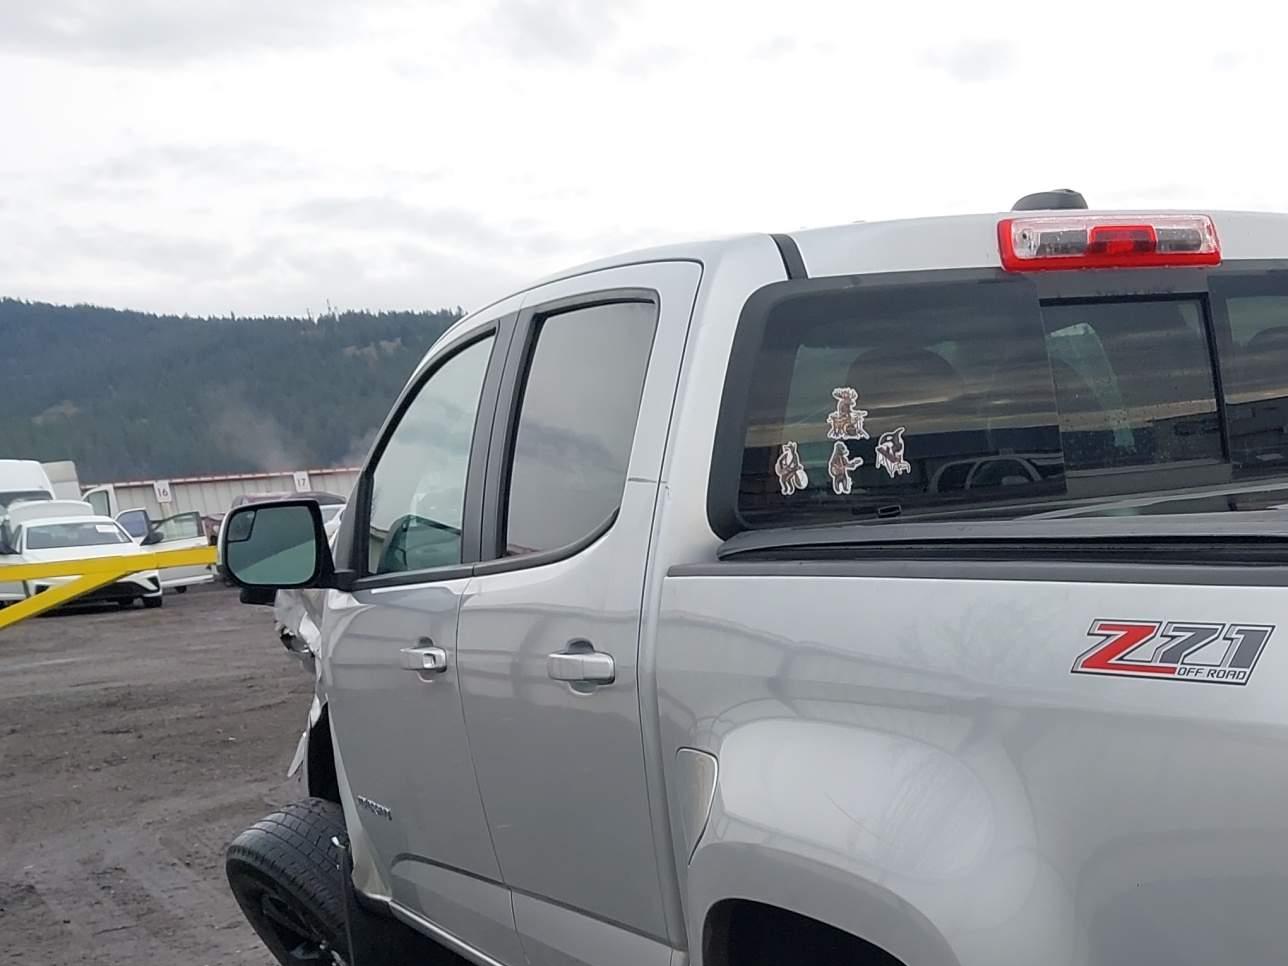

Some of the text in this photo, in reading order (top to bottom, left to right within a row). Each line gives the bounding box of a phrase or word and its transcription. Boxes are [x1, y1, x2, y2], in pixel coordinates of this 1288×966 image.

[296, 478, 307, 487] 17
[157, 487, 169, 498] 16
[1071, 619, 1276, 685] Z71
[1178, 667, 1247, 680] OFF ROAD
